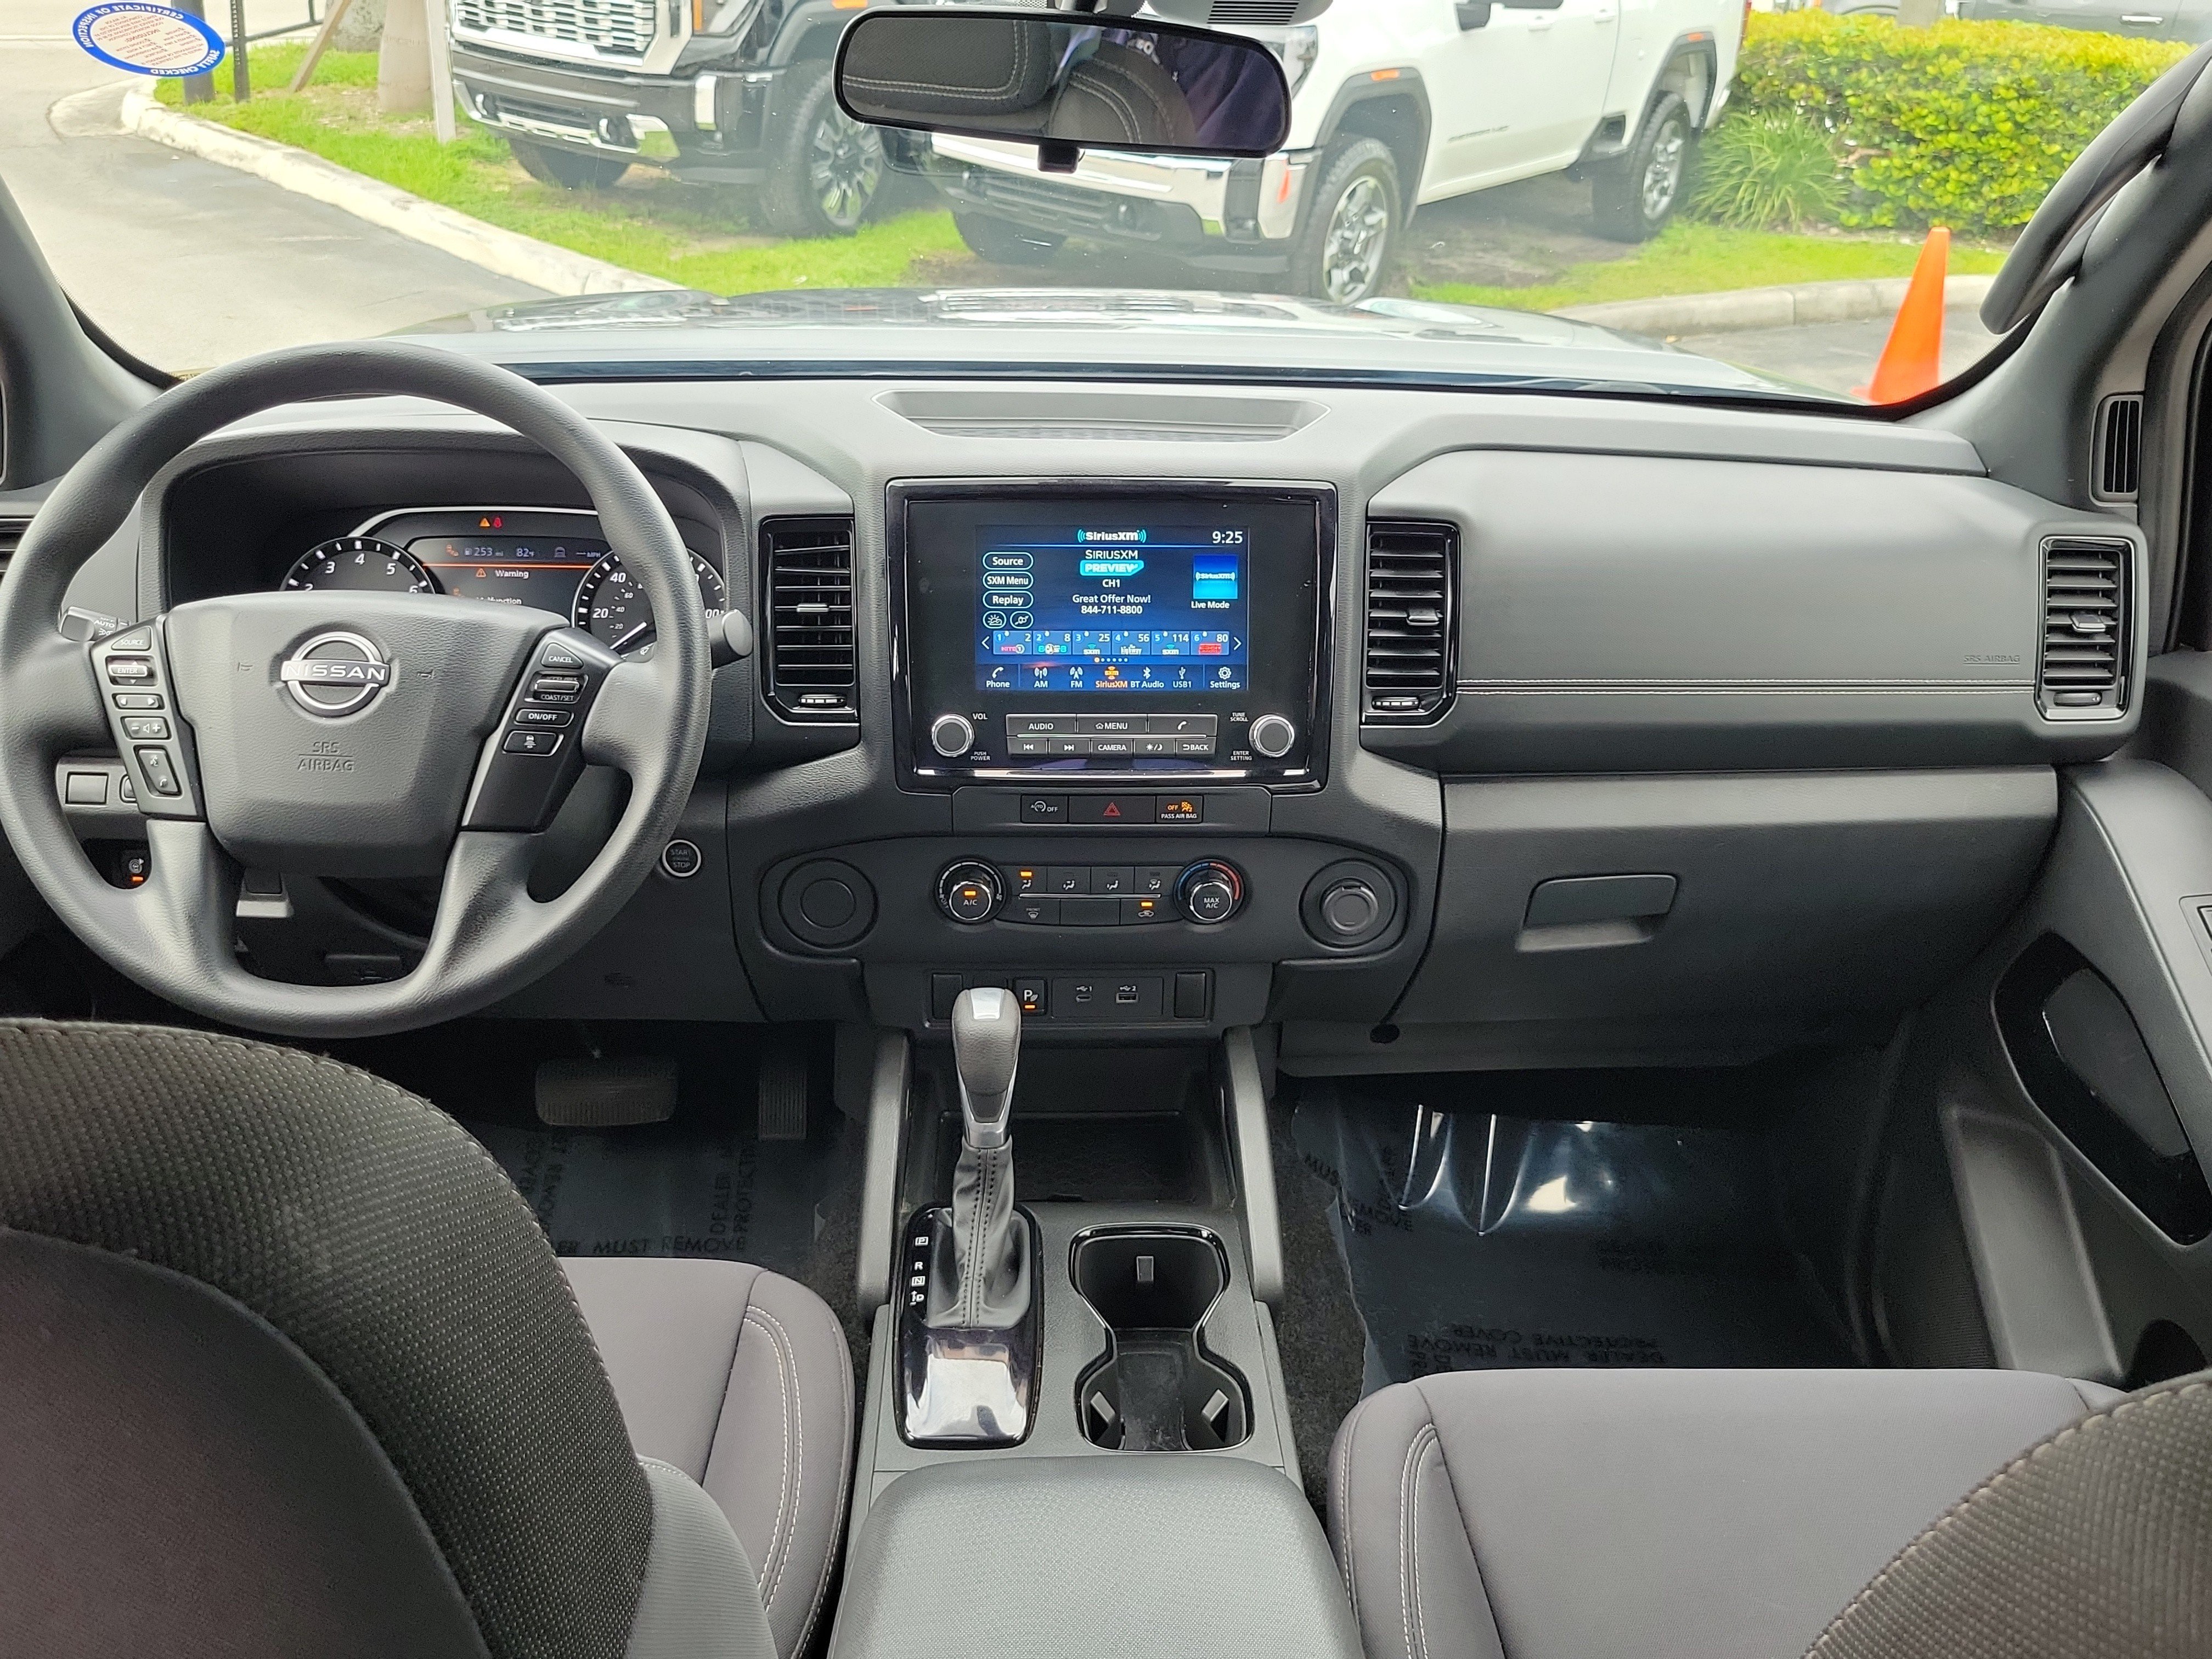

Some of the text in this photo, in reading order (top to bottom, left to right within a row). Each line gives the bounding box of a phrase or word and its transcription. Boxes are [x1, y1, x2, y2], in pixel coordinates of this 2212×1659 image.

[1212, 531, 1243, 544] 9:25
[473, 548, 493, 556] 253
[1085, 549, 1138, 560] SIRIUSXM
[354, 553, 365, 565] 4
[992, 557, 1024, 566] Source
[325, 561, 335, 574] 3
[386, 562, 397, 575] 5
[1085, 563, 1139, 573] PREVIEW
[495, 569, 529, 579] Warning
[610, 572, 627, 583] 40
[987, 576, 1029, 585] SXM Menu
[1102, 579, 1120, 588] CH1
[992, 595, 1024, 606] Replay
[1073, 594, 1151, 603] Great Offer Now!
[1081, 605, 1143, 614] 844-711-8800
[1191, 601, 1230, 609] Live Mode
[592, 608, 609, 618] 20
[94, 620, 115, 628] AUTO
[1025, 634, 1031, 642] 2
[1064, 634, 1071, 642] 8
[1098, 634, 1110, 642] 25
[1138, 634, 1149, 642] 56
[1173, 634, 1189, 642] 114
[1216, 634, 1228, 642] 80
[285, 664, 385, 681] NISSAN
[1210, 680, 1240, 689] Settings
[312, 741, 341, 754] SRS
[297, 759, 354, 772] AIRBAG
[592, 1237, 650, 1254] MUST
[661, 1235, 747, 1252] REMOVE
[914, 1261, 923, 1271] R
[916, 1294, 924, 1302] D
